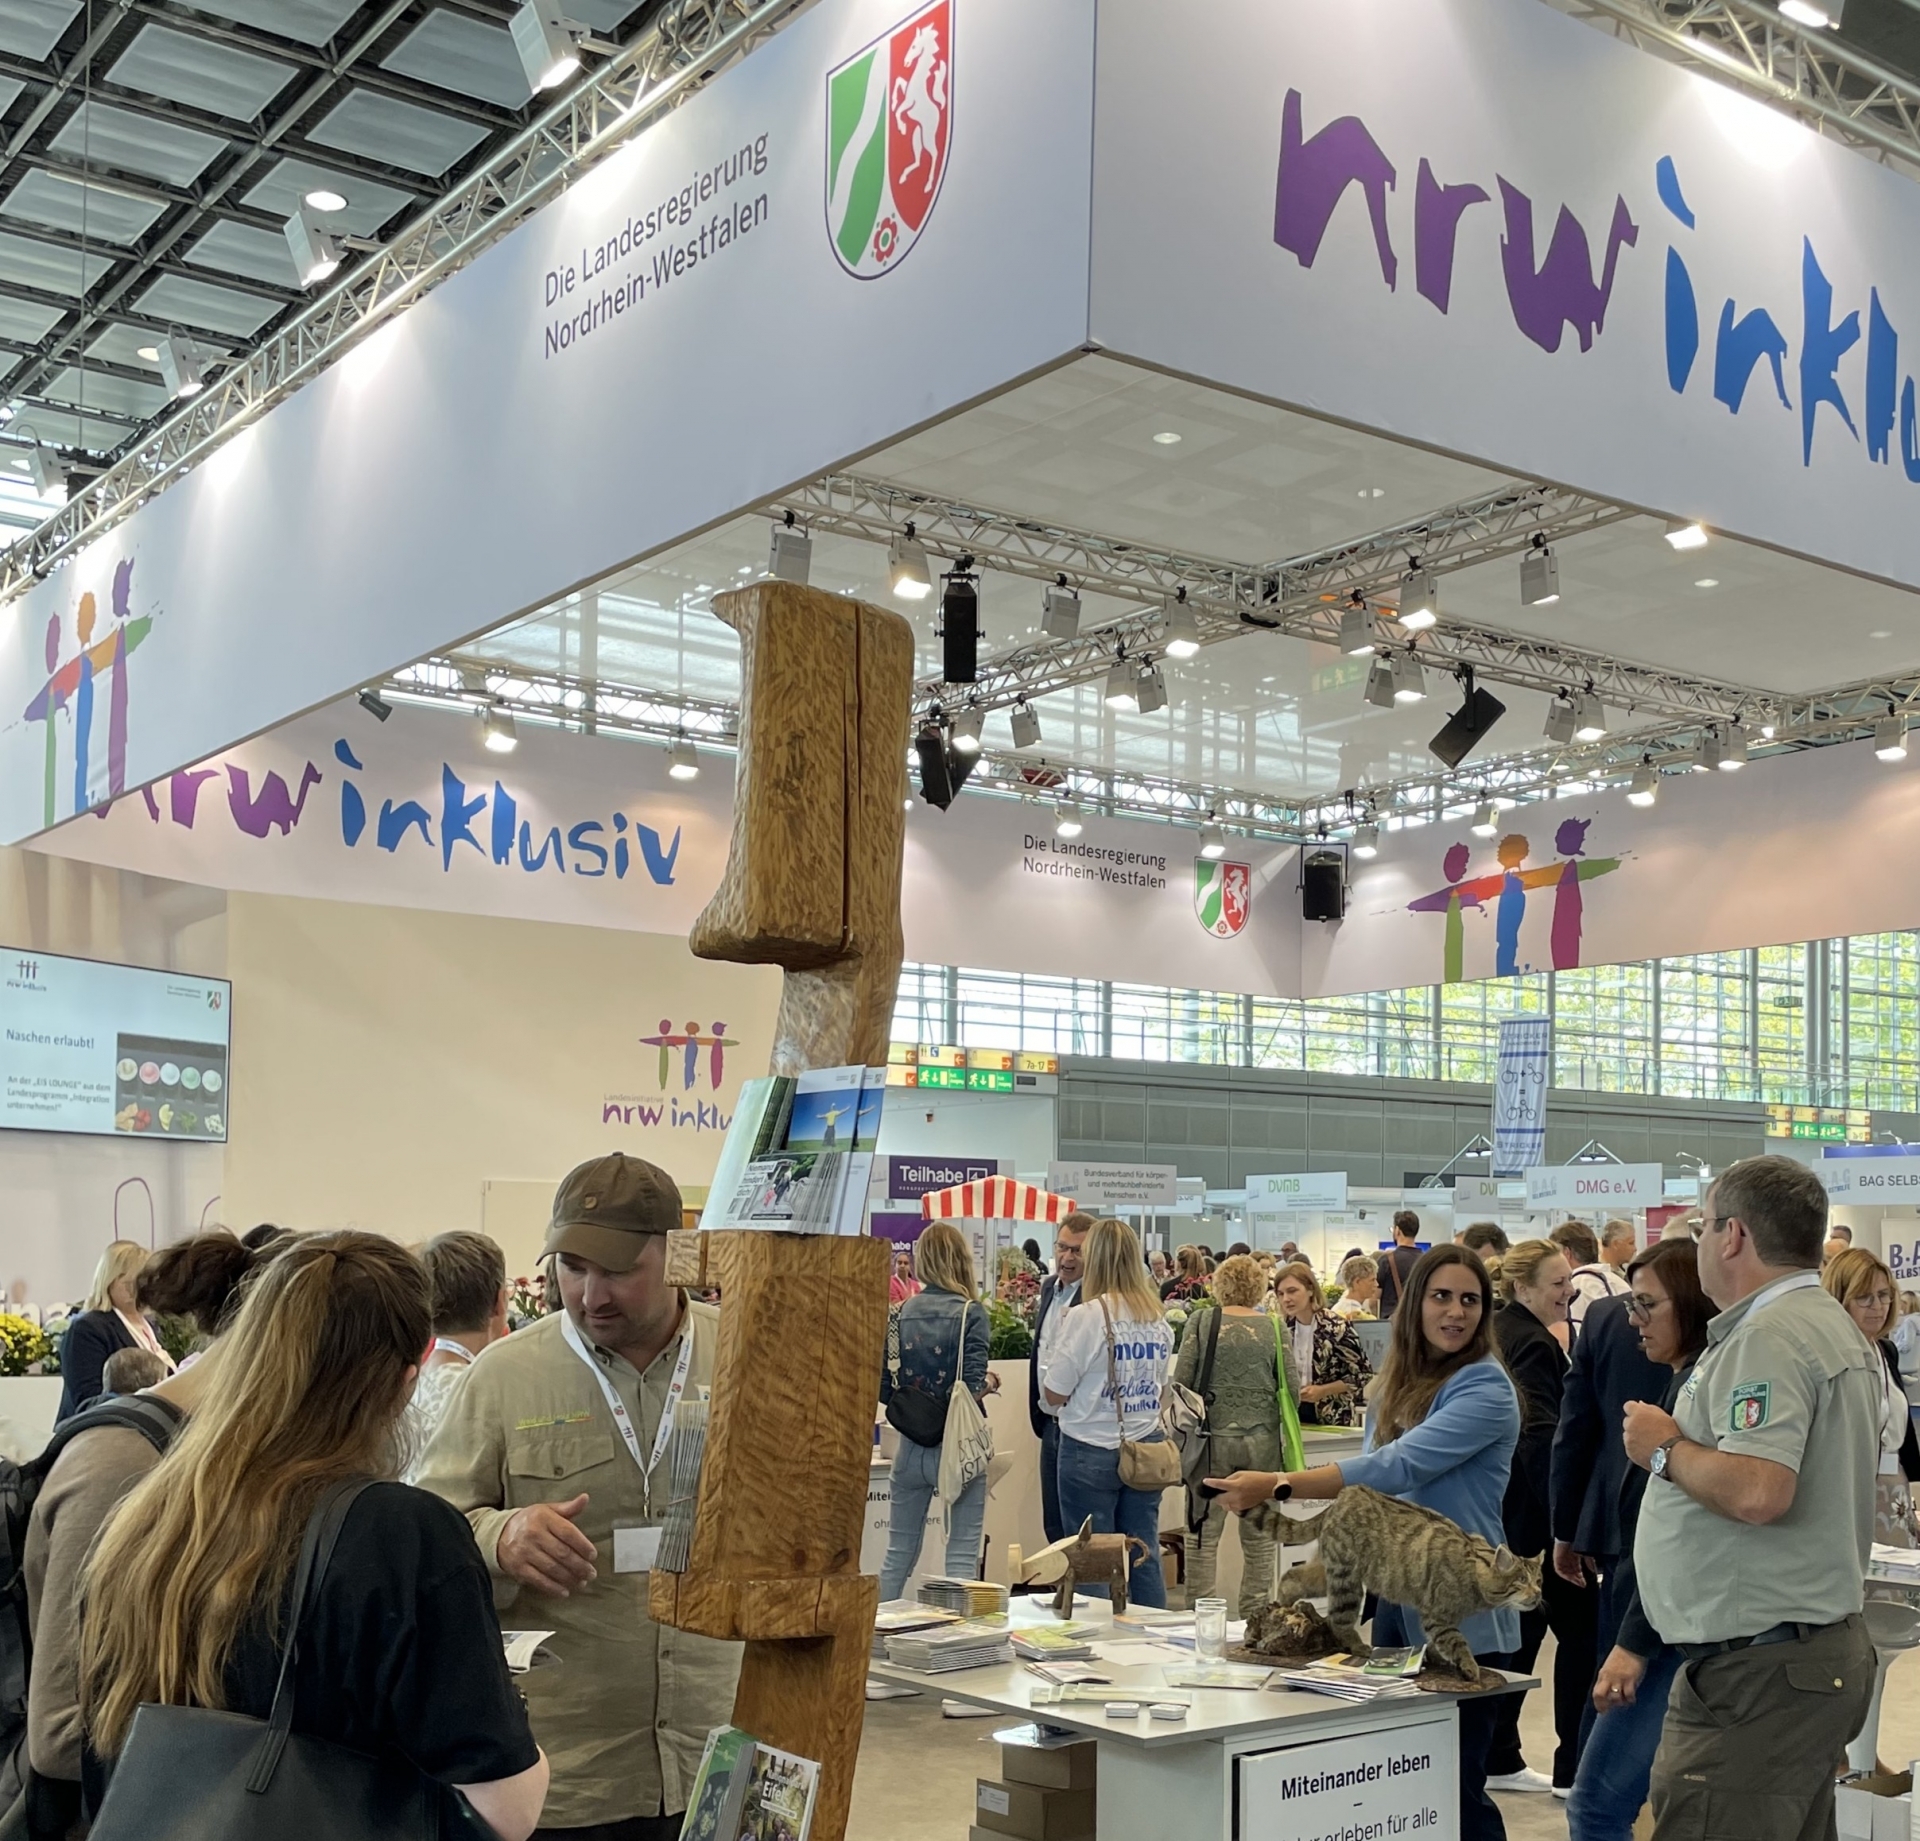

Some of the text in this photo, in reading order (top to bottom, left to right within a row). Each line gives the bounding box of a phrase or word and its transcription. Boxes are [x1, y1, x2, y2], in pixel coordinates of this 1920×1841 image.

[545, 131, 769, 307] Die Landesregierung
[1273, 87, 1640, 354] nrw
[545, 193, 769, 360] Nordrhein-Westfalen
[89, 738, 681, 885] rw inklusiv
[1024, 834, 1166, 871] Die Landesregierung
[1024, 857, 1166, 889] Nordrhein-Westfalen
[6, 1029, 95, 1049] Naschen erlaubt!
[603, 1103, 664, 1127] nrw
[899, 1165, 963, 1183] Teilhabe
[1084, 1169, 1134, 1178] Bundesverband
[1859, 1175, 1884, 1187] BAG
[1104, 1191, 1137, 1199] Menschen
[1480, 1182, 1497, 1196] DV
[1576, 1179, 1637, 1194] DMG e.V.
[1108, 1342, 1167, 1361] more
[1281, 1754, 1431, 1801] Miteinander leben
[1324, 1806, 1438, 1841] erleben für alle
